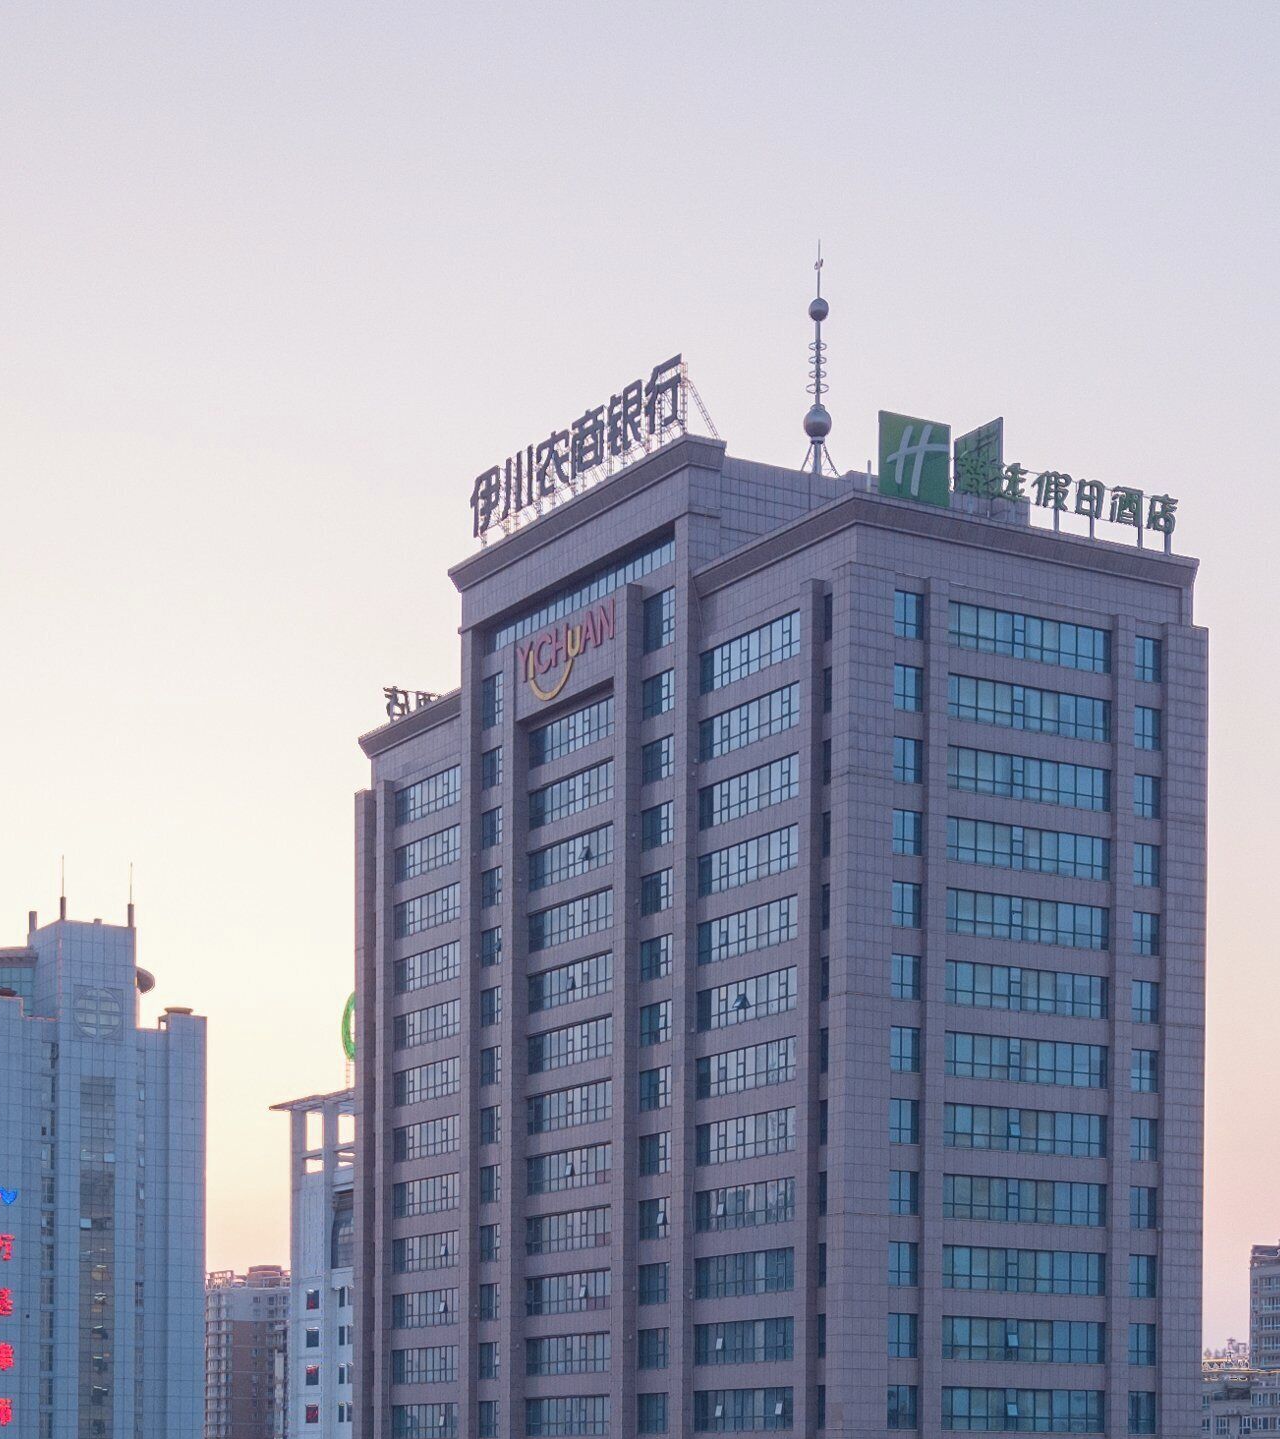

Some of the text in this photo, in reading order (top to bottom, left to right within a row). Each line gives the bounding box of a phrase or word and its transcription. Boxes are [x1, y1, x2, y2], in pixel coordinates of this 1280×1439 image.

[470, 353, 682, 538] 伊川农商银行
